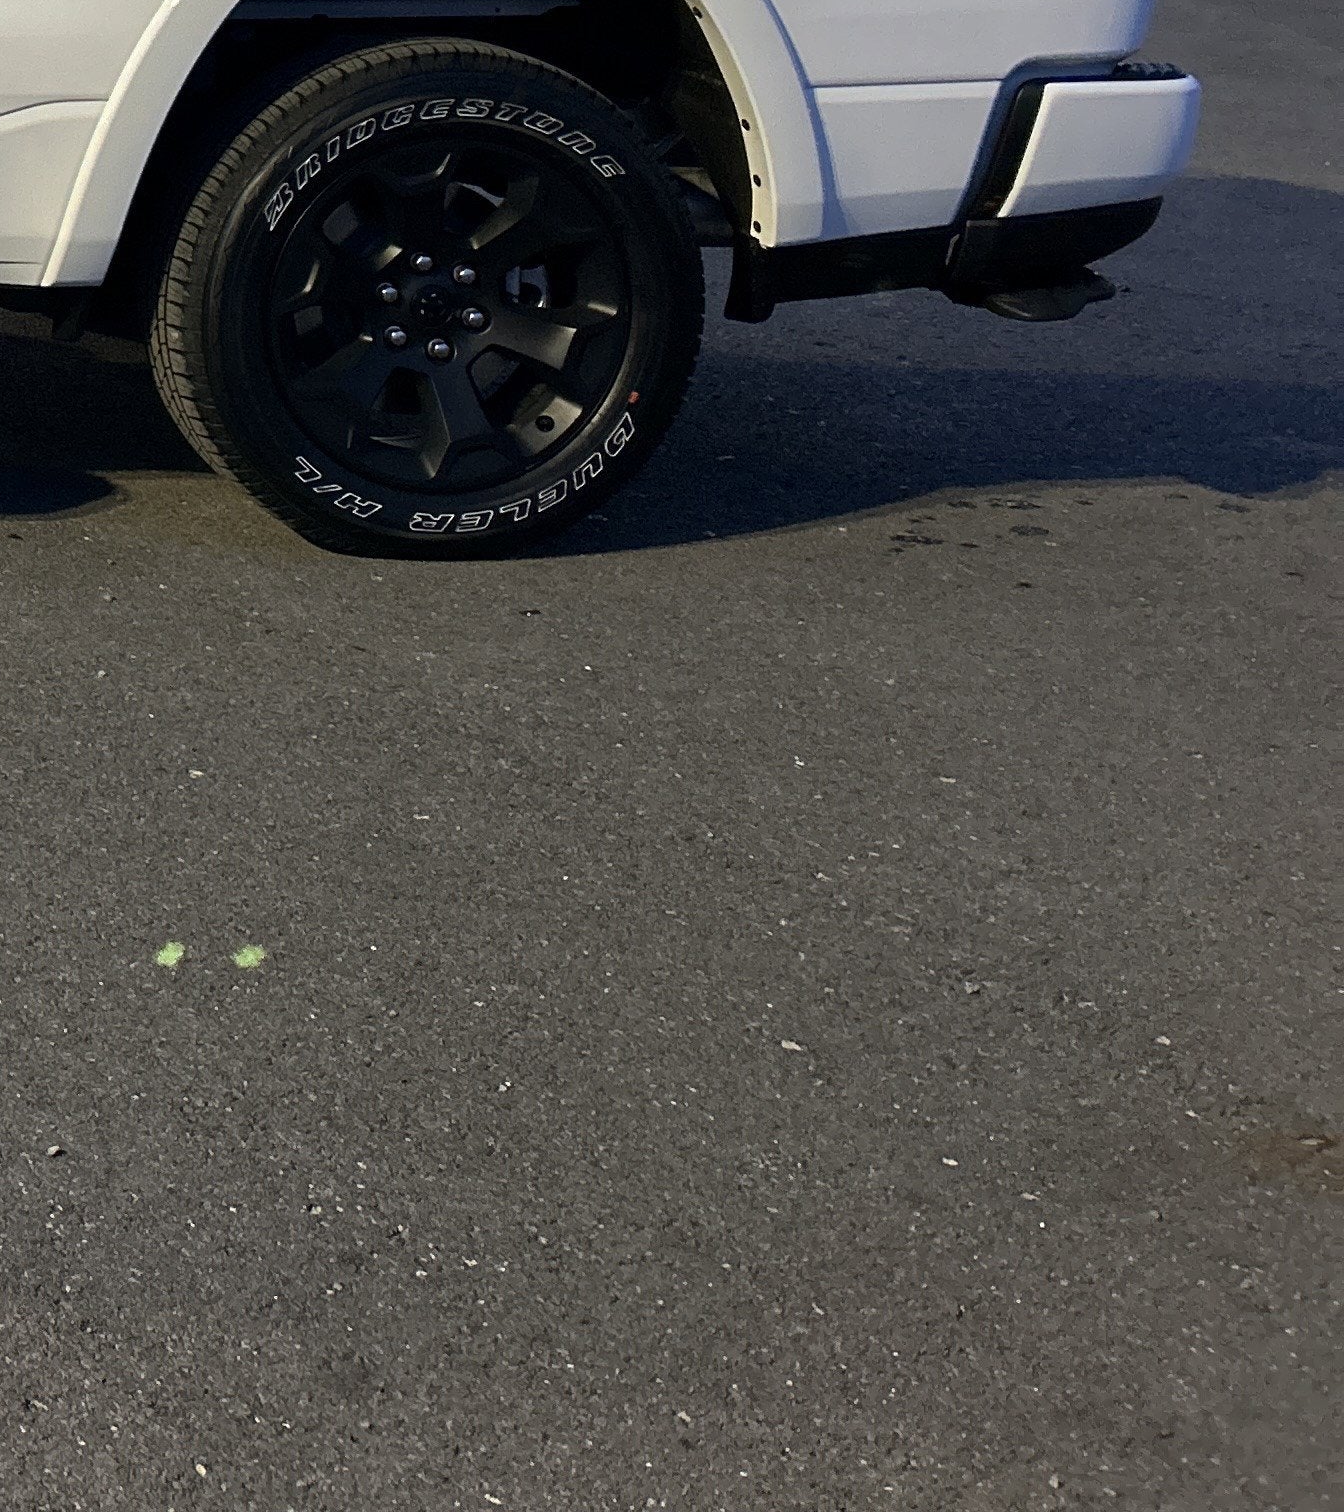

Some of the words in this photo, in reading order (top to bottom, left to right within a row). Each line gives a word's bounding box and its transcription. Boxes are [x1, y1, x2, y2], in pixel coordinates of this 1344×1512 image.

[263, 97, 628, 232] BRIDGESTONE
[293, 454, 384, 520] H/L
[408, 410, 636, 534] DUELER
